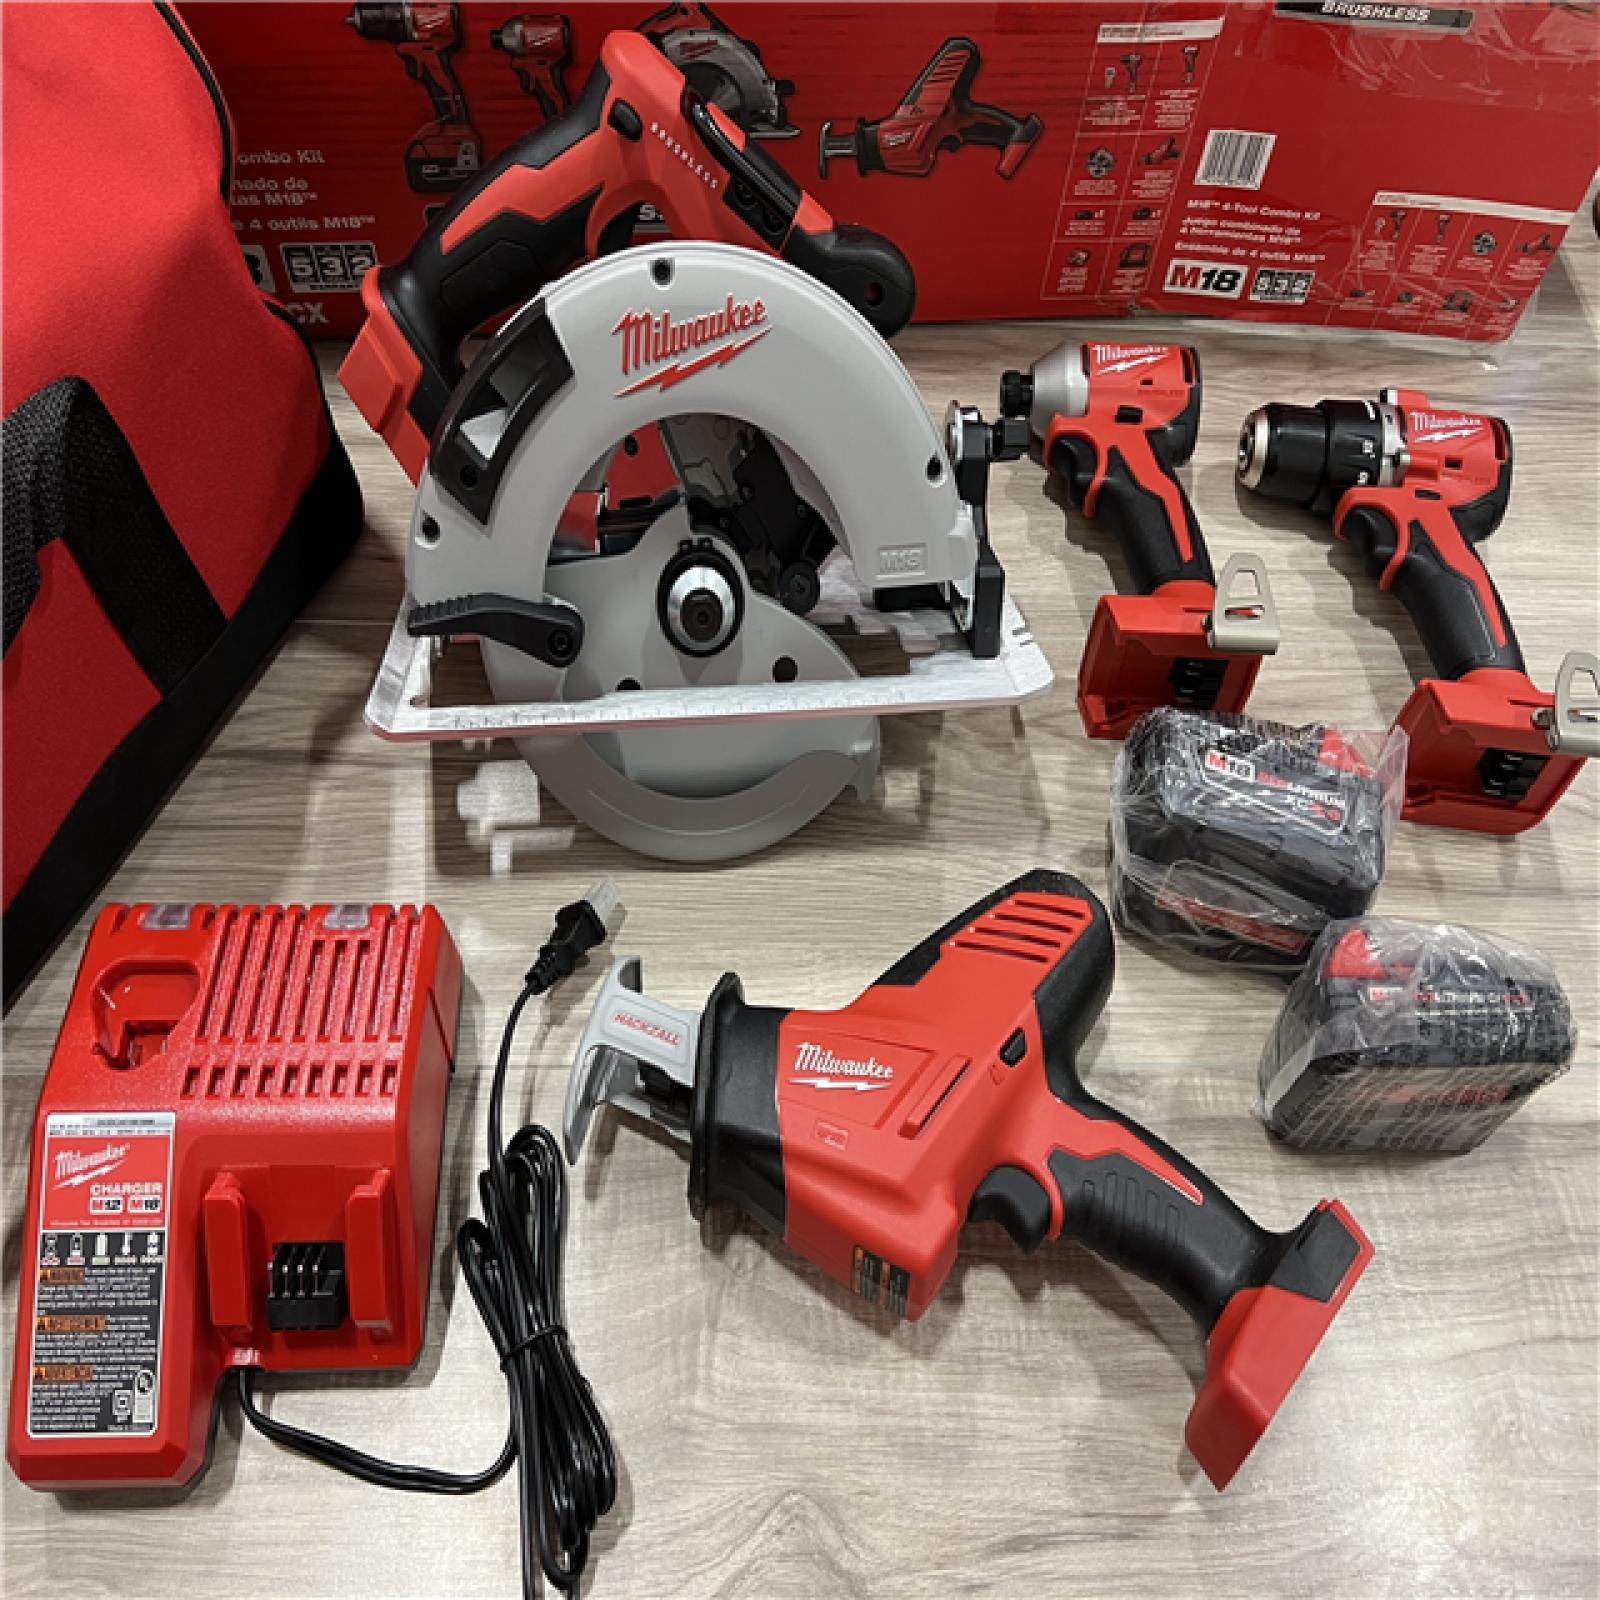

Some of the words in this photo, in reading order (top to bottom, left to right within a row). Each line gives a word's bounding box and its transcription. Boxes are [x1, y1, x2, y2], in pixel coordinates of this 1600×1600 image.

[1322, 0, 1430, 22] BRUSHLESS
[237, 150, 292, 164] ombo
[297, 150, 325, 164] Kit
[651, 121, 718, 189] BRUSHLESS
[234, 177, 278, 190] nado
[285, 177, 309, 190] de
[250, 218, 263, 230] 4
[268, 216, 320, 230] outils
[292, 256, 313, 276] 5
[320, 256, 343, 276] 3
[1171, 264, 1242, 292] M18
[610, 293, 768, 376] Milwaukee
[1410, 411, 1482, 432] Milwaukee
[794, 1041, 895, 1079] Milwaukee
[54, 1143, 128, 1180] Milwaukee
[90, 1182, 163, 1196] CHARGER
[91, 1198, 122, 1212] M12
[129, 1197, 161, 1211] M18
